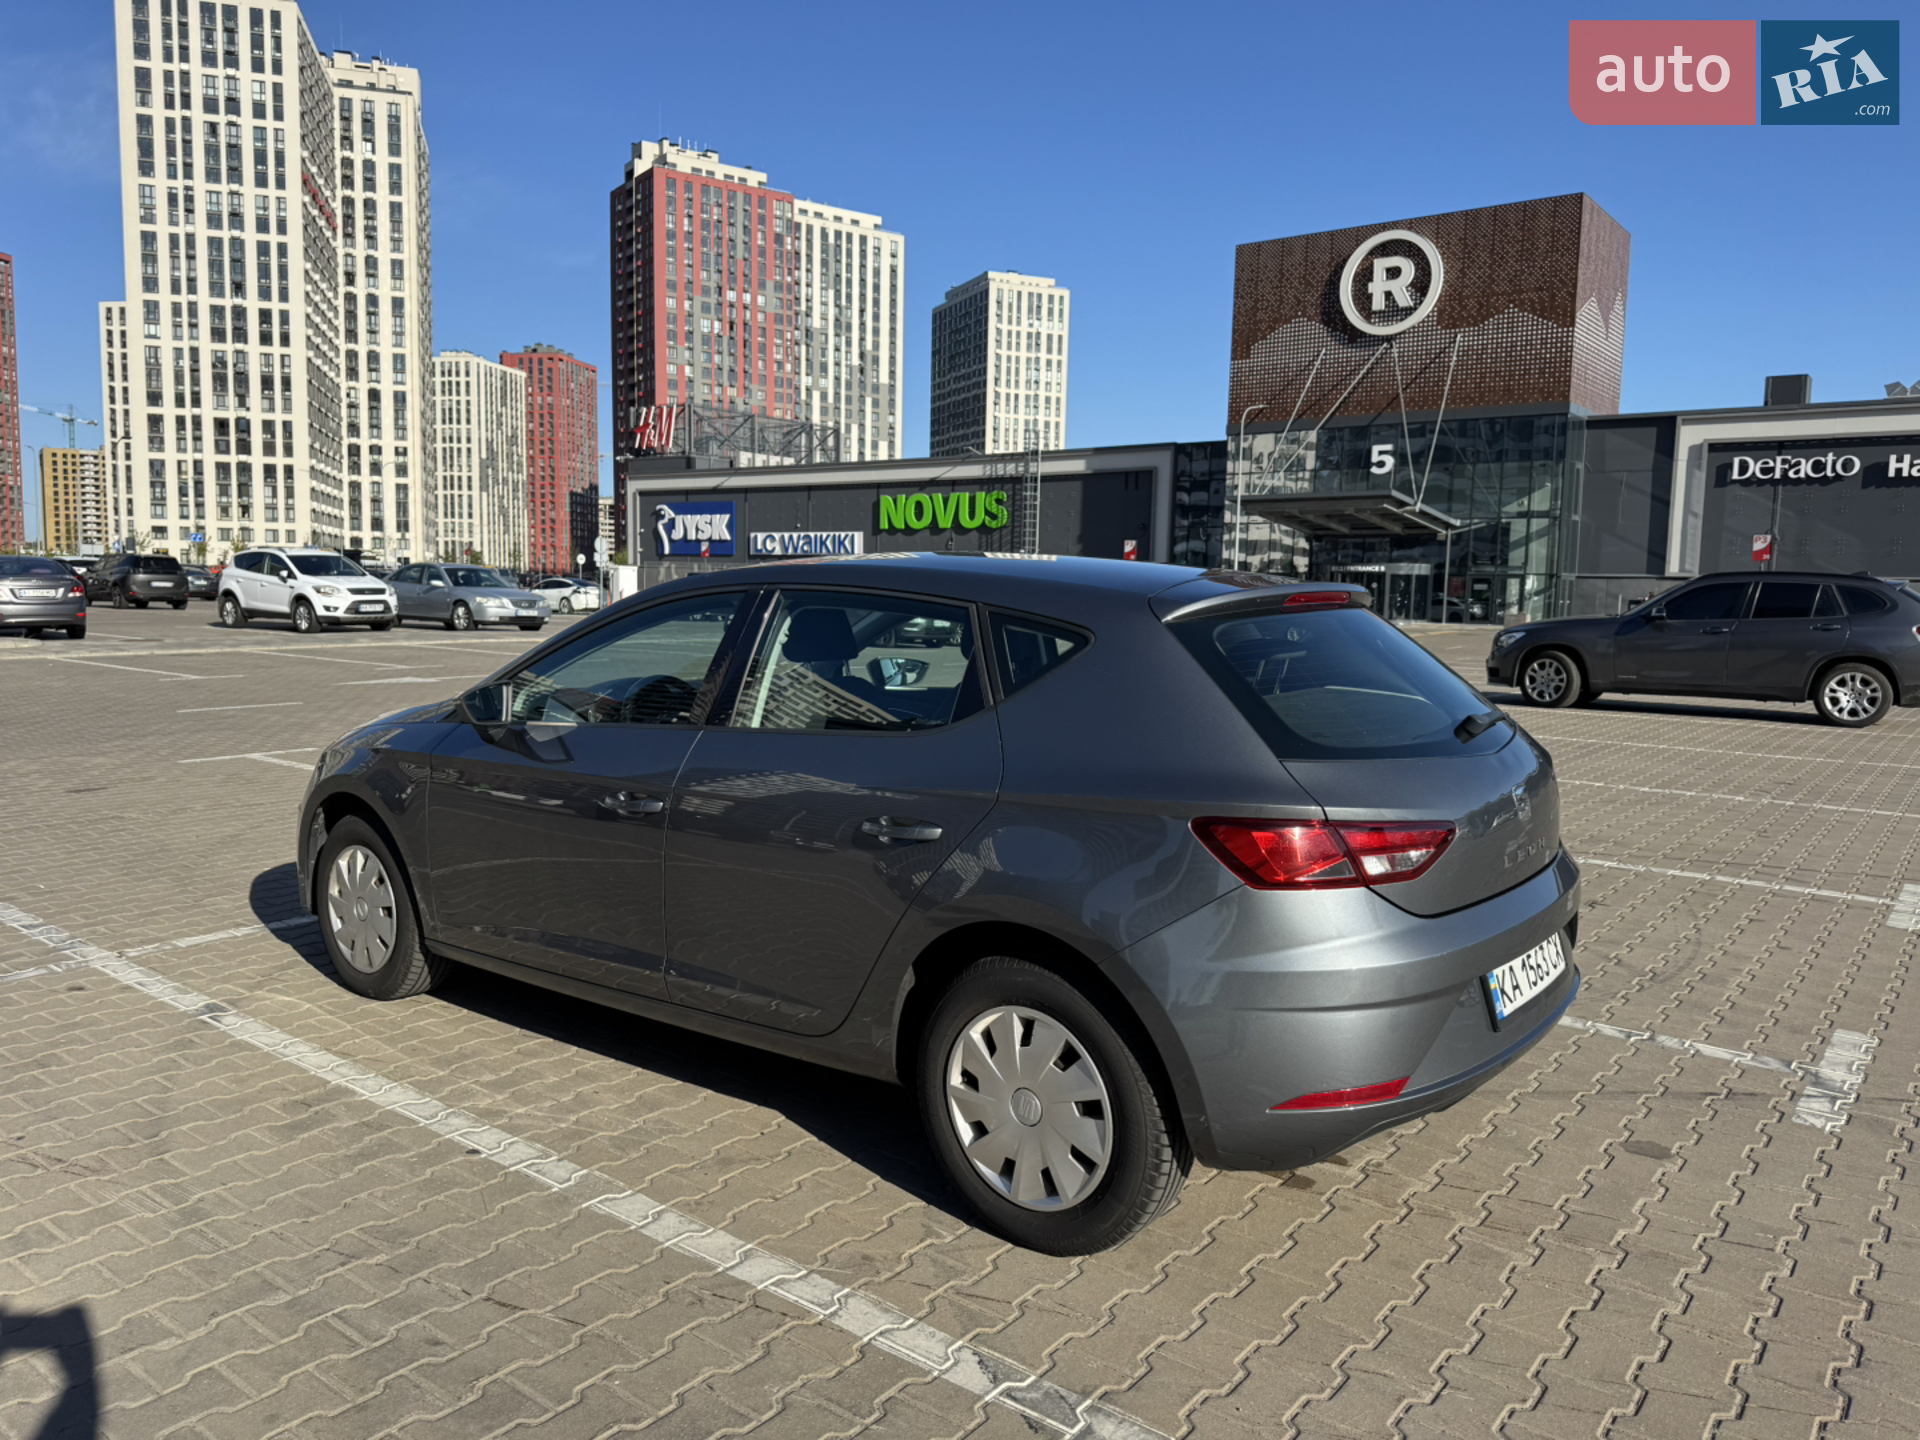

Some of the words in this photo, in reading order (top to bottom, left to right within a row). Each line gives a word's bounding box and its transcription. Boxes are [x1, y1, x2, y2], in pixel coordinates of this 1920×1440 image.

[634, 404, 676, 450] H&M
[1370, 443, 1395, 475] 5
[1731, 452, 1861, 480] DeFacto
[879, 490, 1008, 530] NOVUS
[671, 514, 731, 541] JYSK
[753, 534, 777, 554] LC
[1496, 965, 1524, 1008] KA
